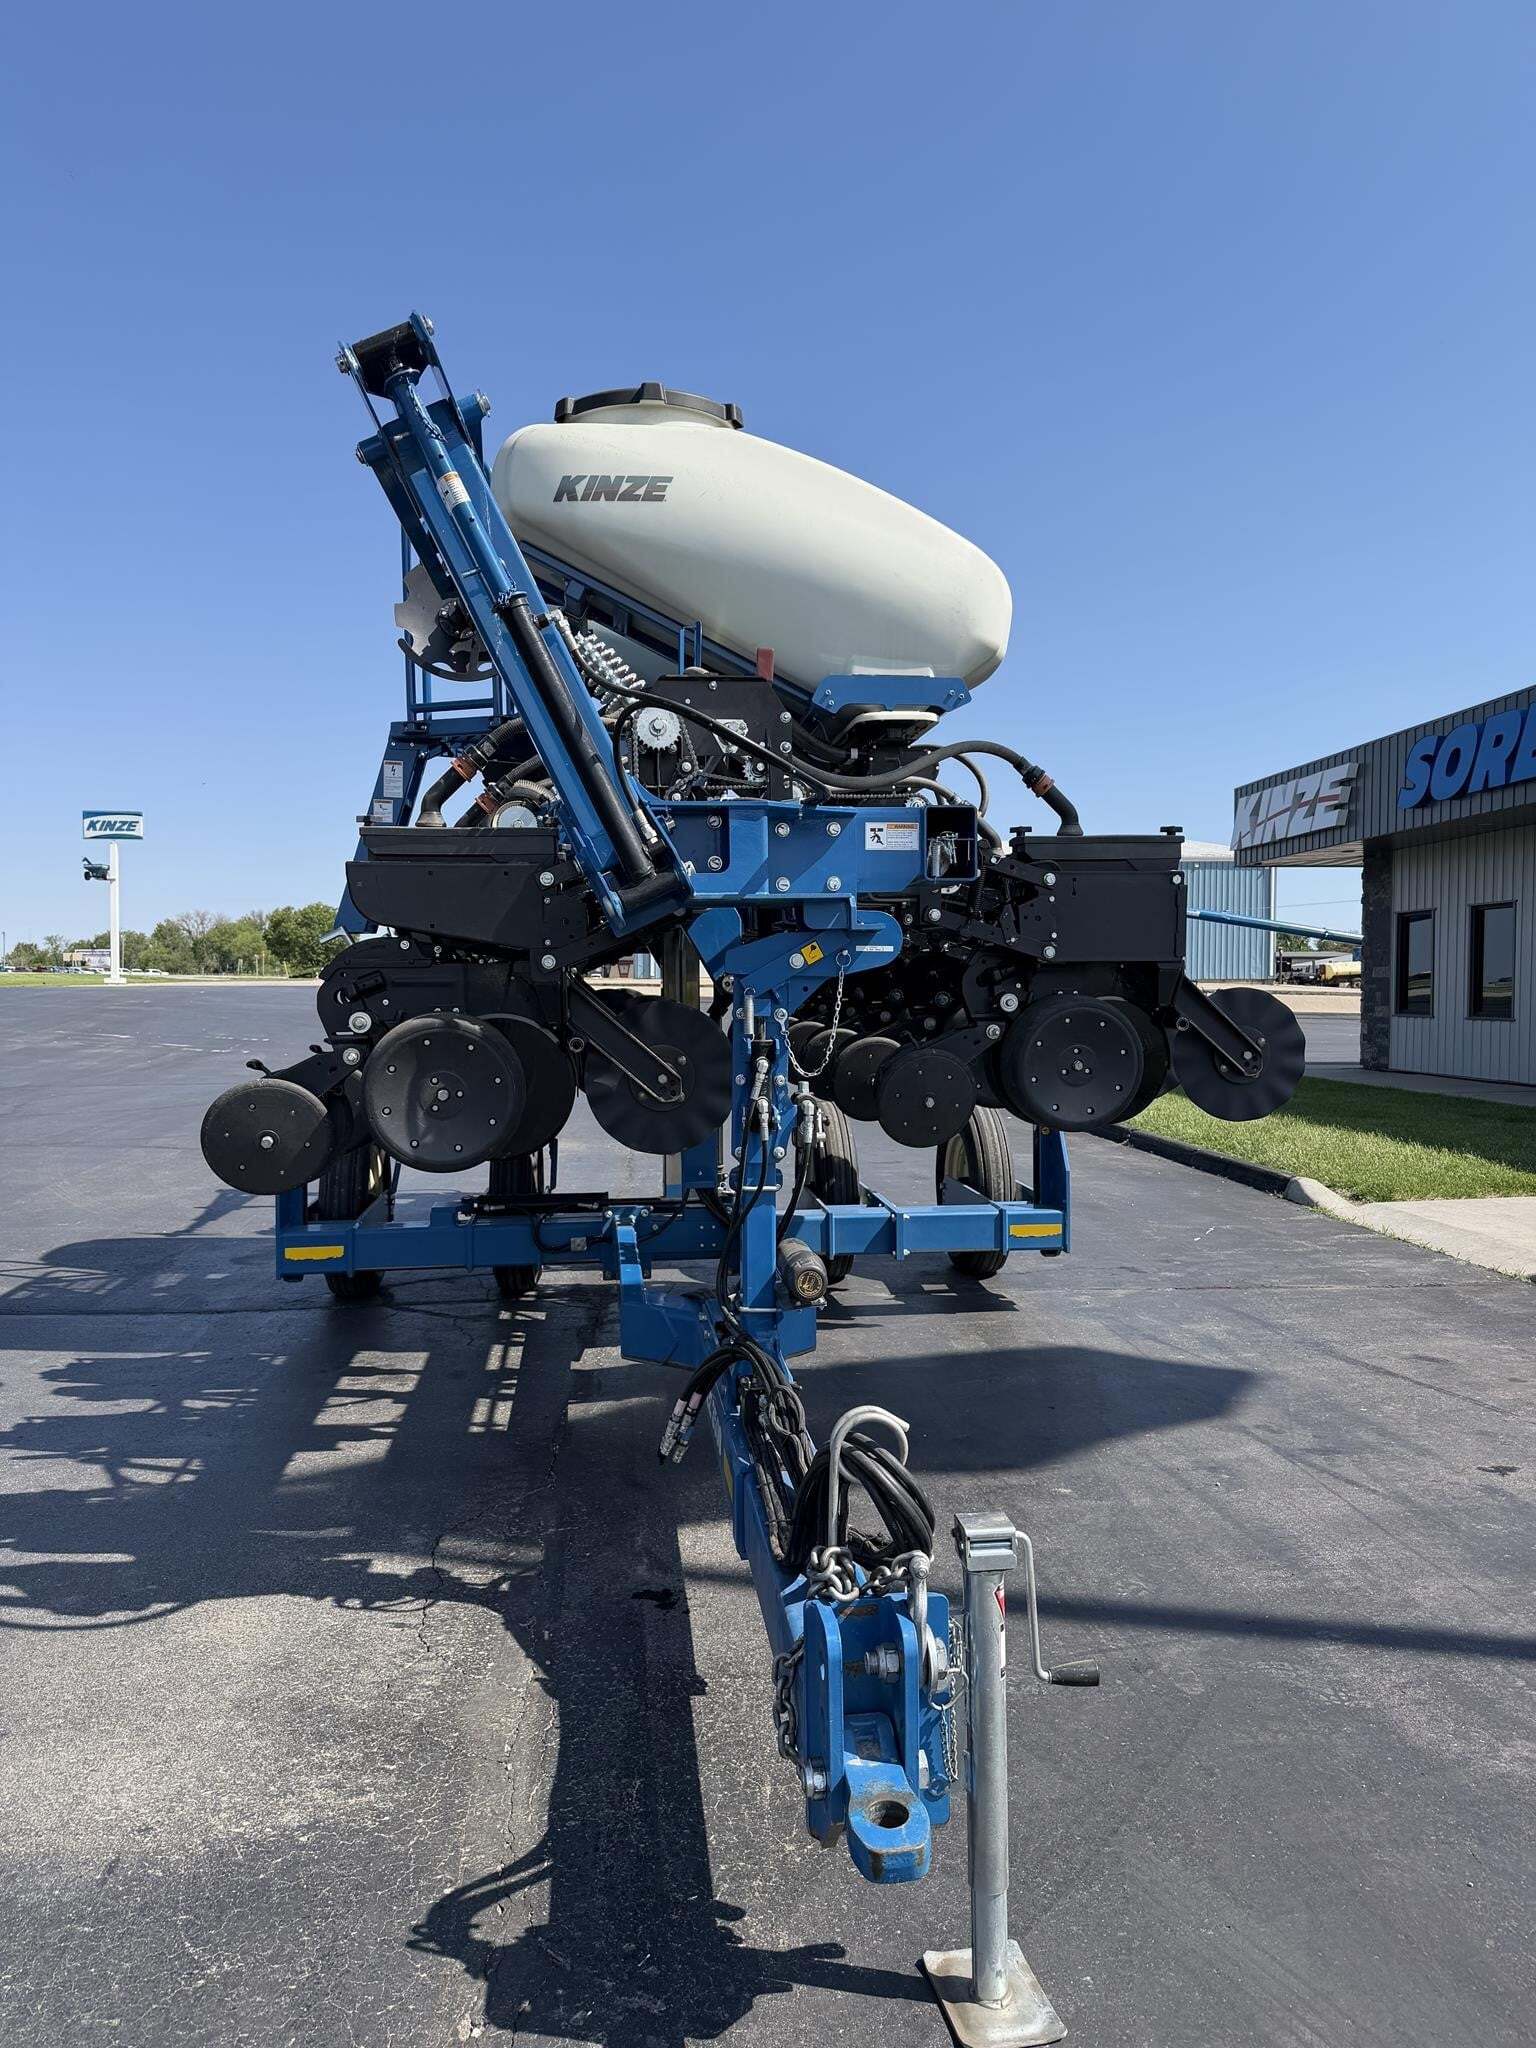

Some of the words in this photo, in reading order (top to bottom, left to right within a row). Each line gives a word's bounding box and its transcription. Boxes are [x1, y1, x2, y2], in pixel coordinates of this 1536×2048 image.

[553, 475, 674, 502] KINZE
[1230, 762, 1358, 850] KINZE
[86, 820, 139, 831] KINZE
